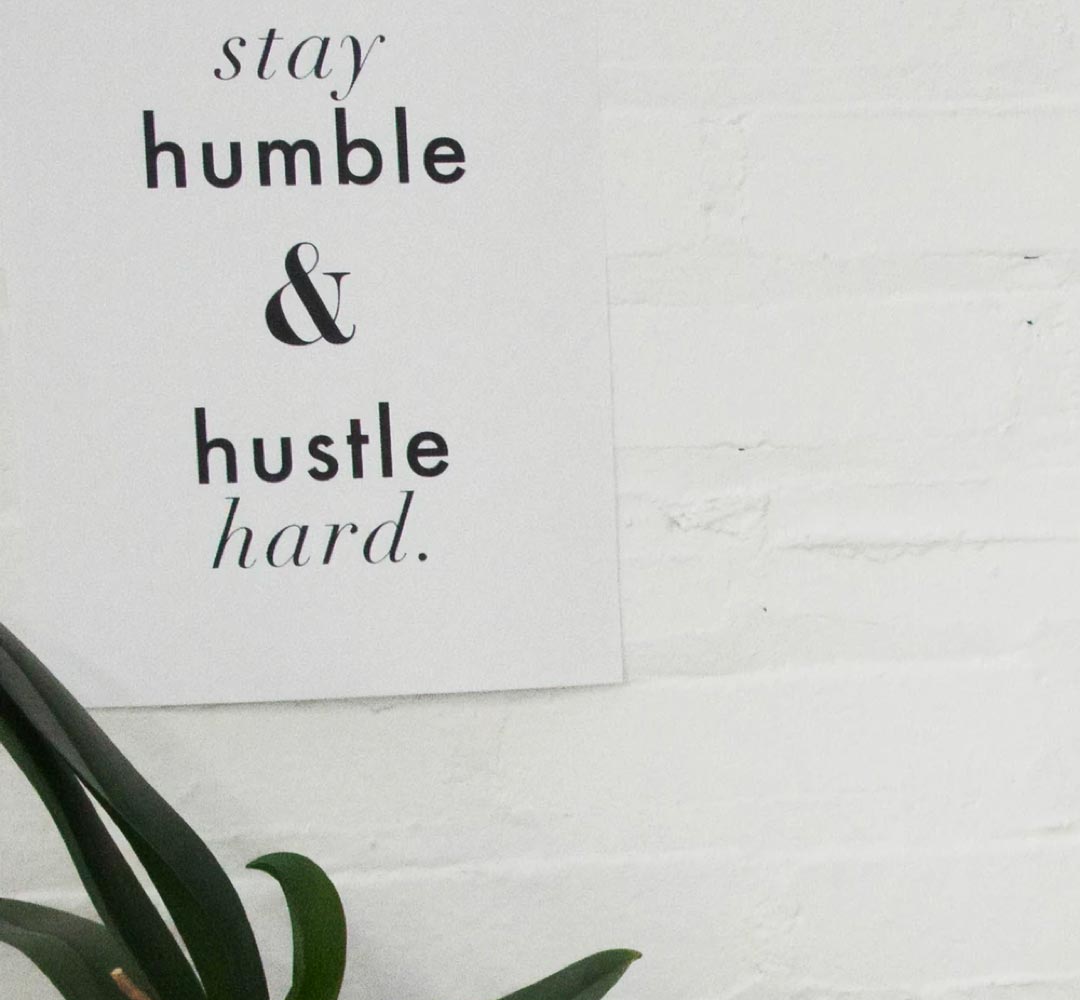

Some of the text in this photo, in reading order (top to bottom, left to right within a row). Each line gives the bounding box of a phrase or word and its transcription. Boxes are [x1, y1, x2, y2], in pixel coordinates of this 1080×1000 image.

[213, 28, 386, 102] stay
[142, 106, 467, 189] humble
[265, 242, 356, 347] &
[194, 402, 450, 485] hustle
[211, 490, 429, 570] hard.
